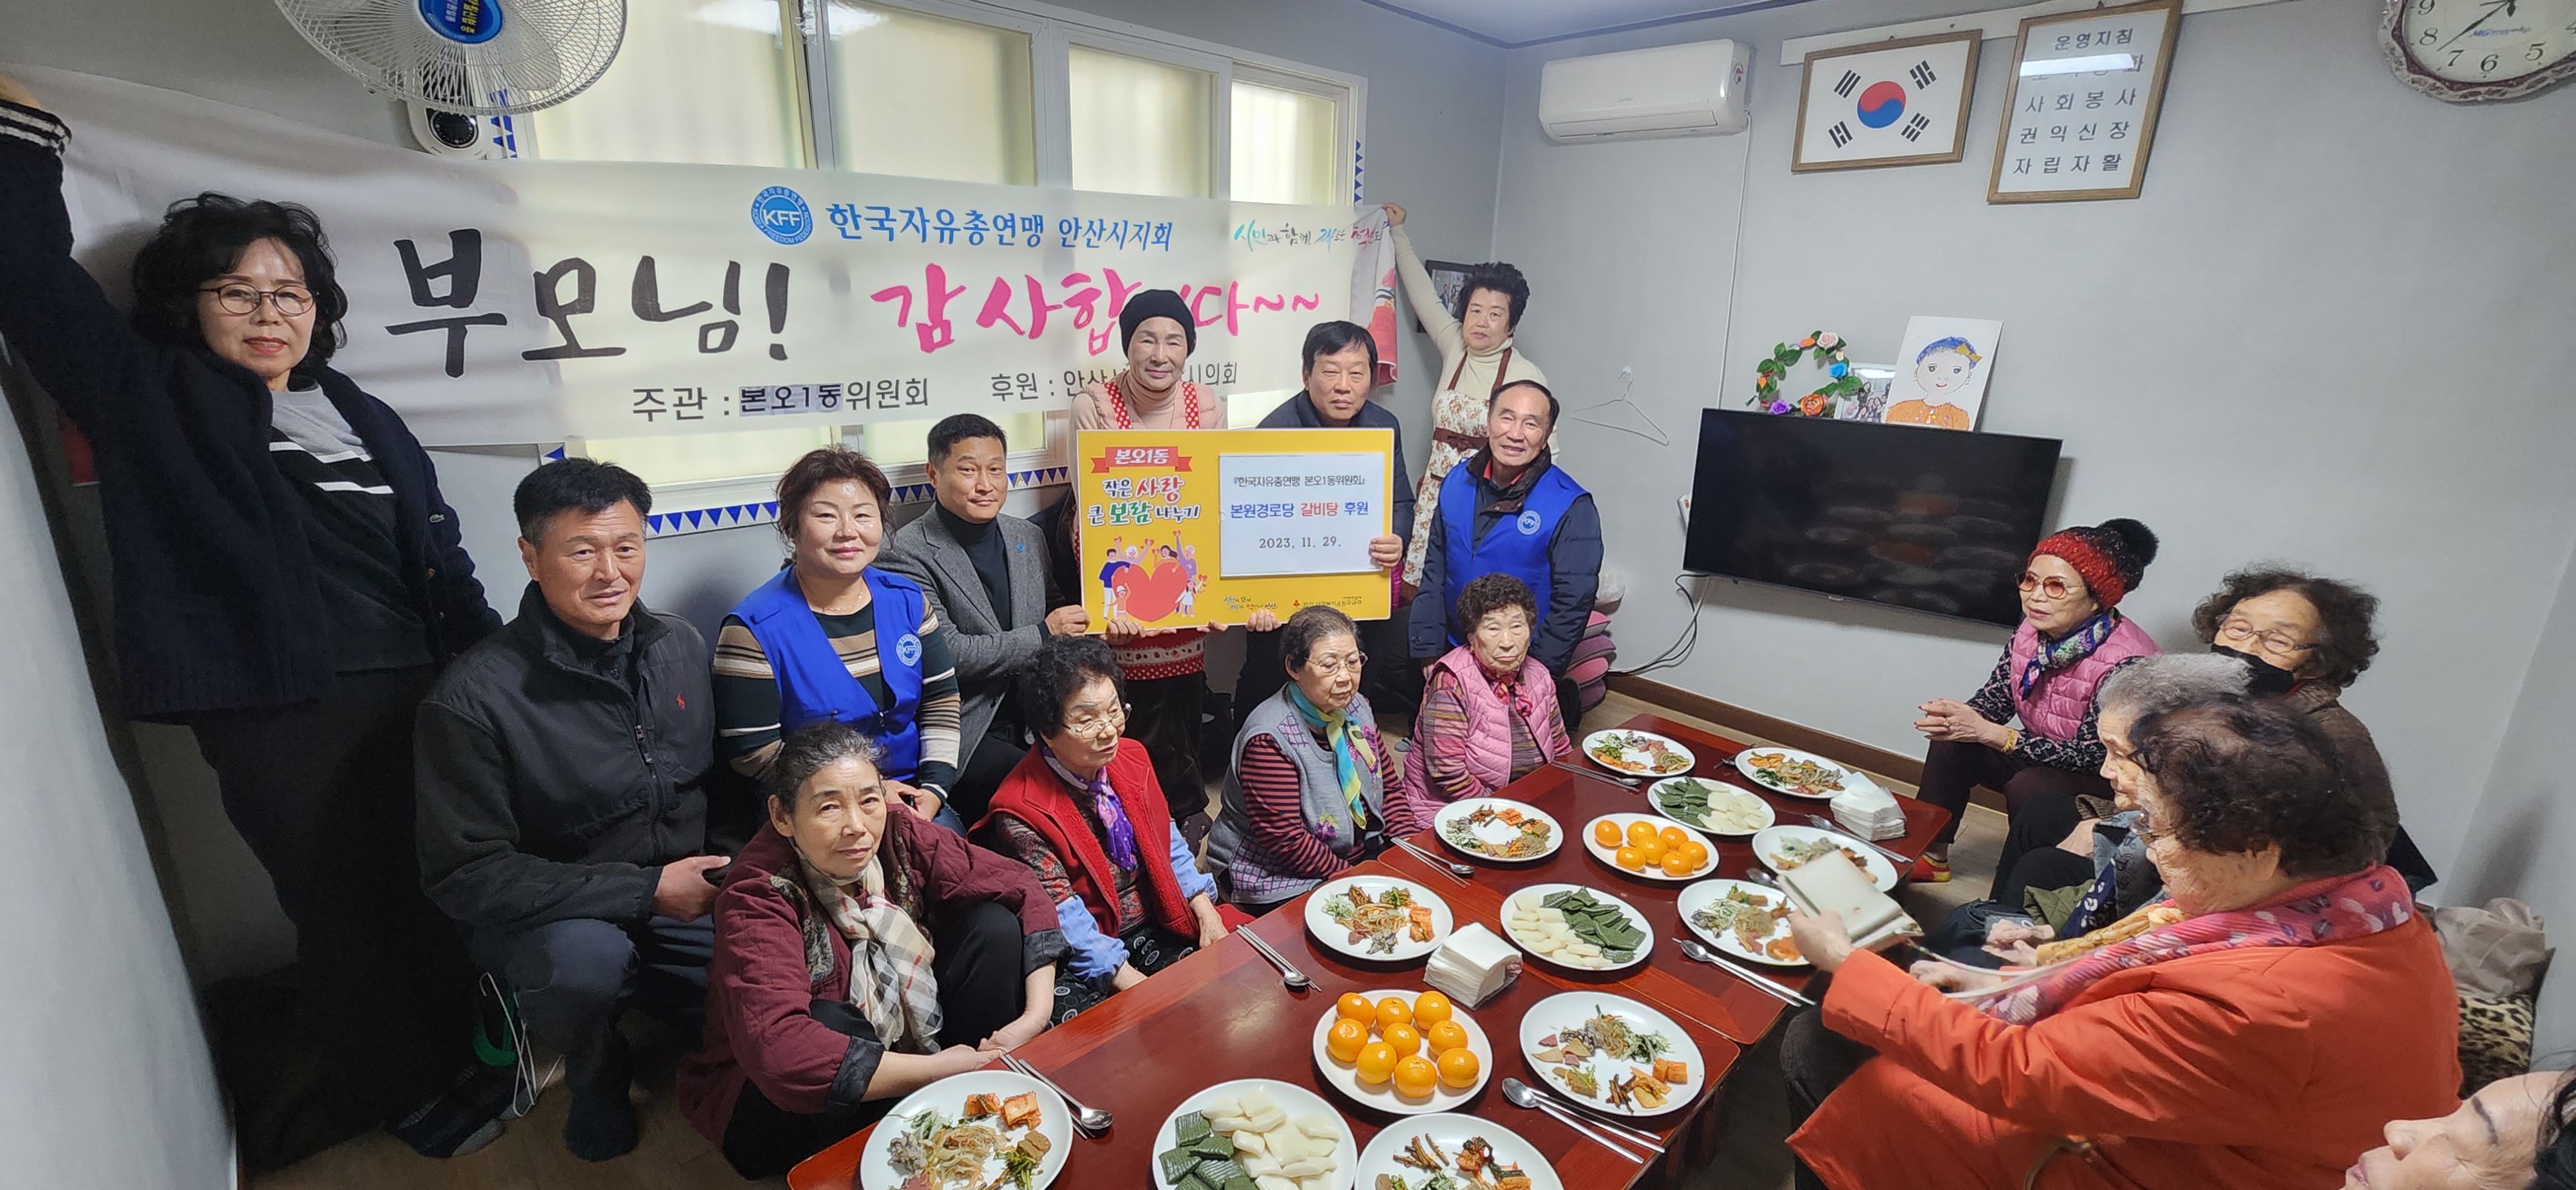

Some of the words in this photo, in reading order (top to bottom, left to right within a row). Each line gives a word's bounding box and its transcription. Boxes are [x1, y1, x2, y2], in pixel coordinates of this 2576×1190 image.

[2054, 28, 2134, 51] 운영지침
[2419, 28, 2438, 46] 8
[2448, 50, 2465, 67] 7
[2481, 54, 2499, 72] 6
[2524, 42, 2546, 61] 5
[752, 208, 764, 229] KOREA
[763, 229, 795, 243] FREEDOM
[795, 212, 811, 243] FEDERATION
[762, 209, 800, 226] KFF
[825, 203, 1044, 248] 한국자유총연맹
[1058, 216, 1173, 252] 안산시지회
[386, 229, 790, 378] 부모님!
[870, 262, 1320, 356] 감사합다~~
[990, 372, 1039, 402] 후원
[1182, 361, 1237, 386] 시의회
[632, 386, 708, 422] 주관
[740, 377, 929, 414] 본오1동위원회
[1114, 448, 1170, 465] 본오1동
[1103, 478, 1132, 498] 작은
[1136, 477, 1184, 503] 사랑
[1088, 505, 1104, 525] 큰
[1110, 502, 1153, 524] 보람
[1157, 506, 1200, 522] 나누기
[1231, 503, 1294, 518] 본원경로당
[1301, 502, 1338, 516] 갈비탕
[1344, 501, 1368, 516] 후원
[1259, 538, 1295, 549] 2023.
[1302, 537, 1316, 547] 11.
[1322, 536, 1341, 547] 29.
